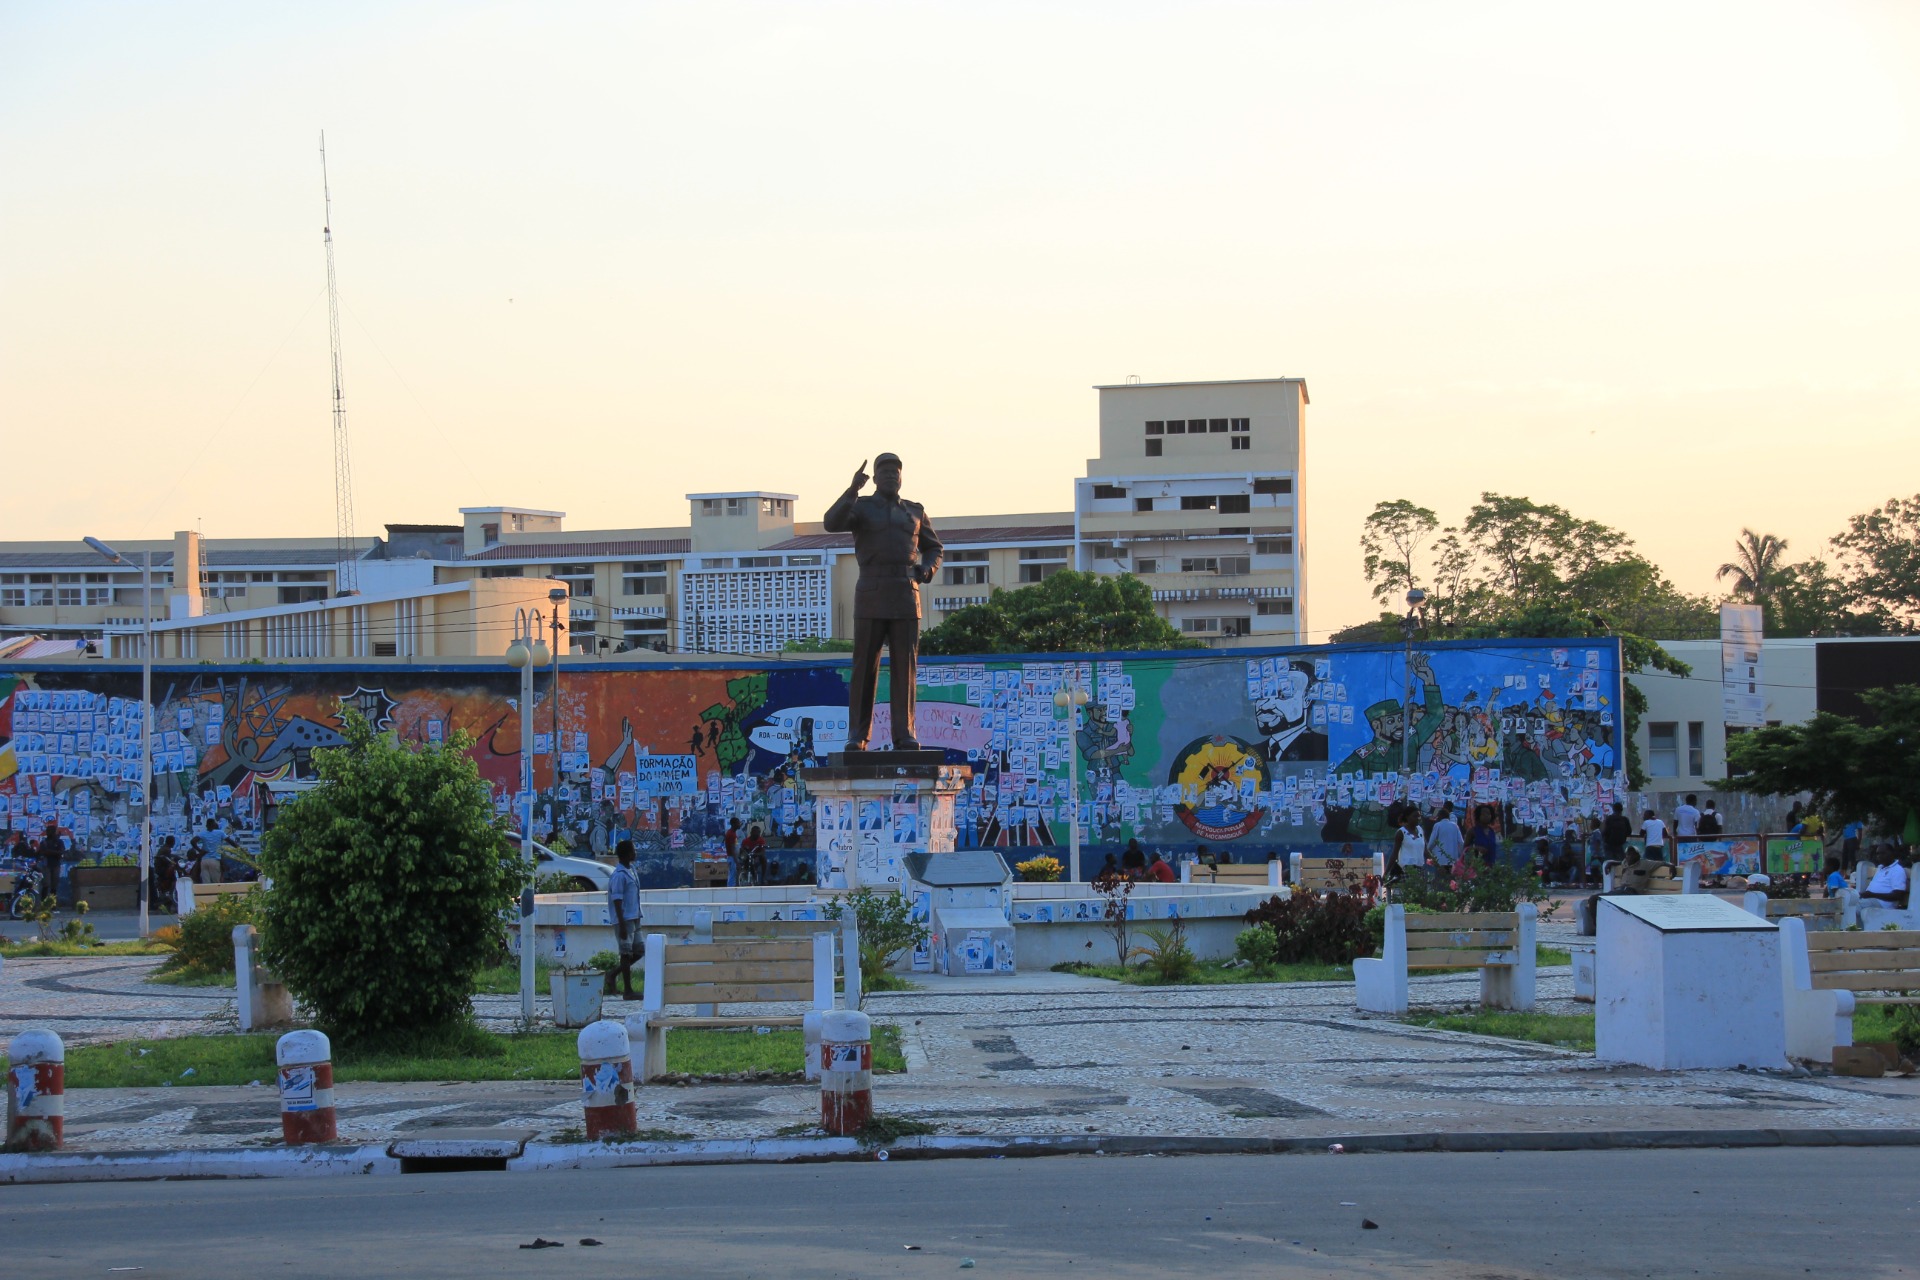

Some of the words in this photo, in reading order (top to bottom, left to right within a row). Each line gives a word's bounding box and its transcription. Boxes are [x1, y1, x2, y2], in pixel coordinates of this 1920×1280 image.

[639, 755, 694, 769] FORMAÇÃO
[639, 771, 653, 781] DO
[658, 782, 683, 792] NOVO
